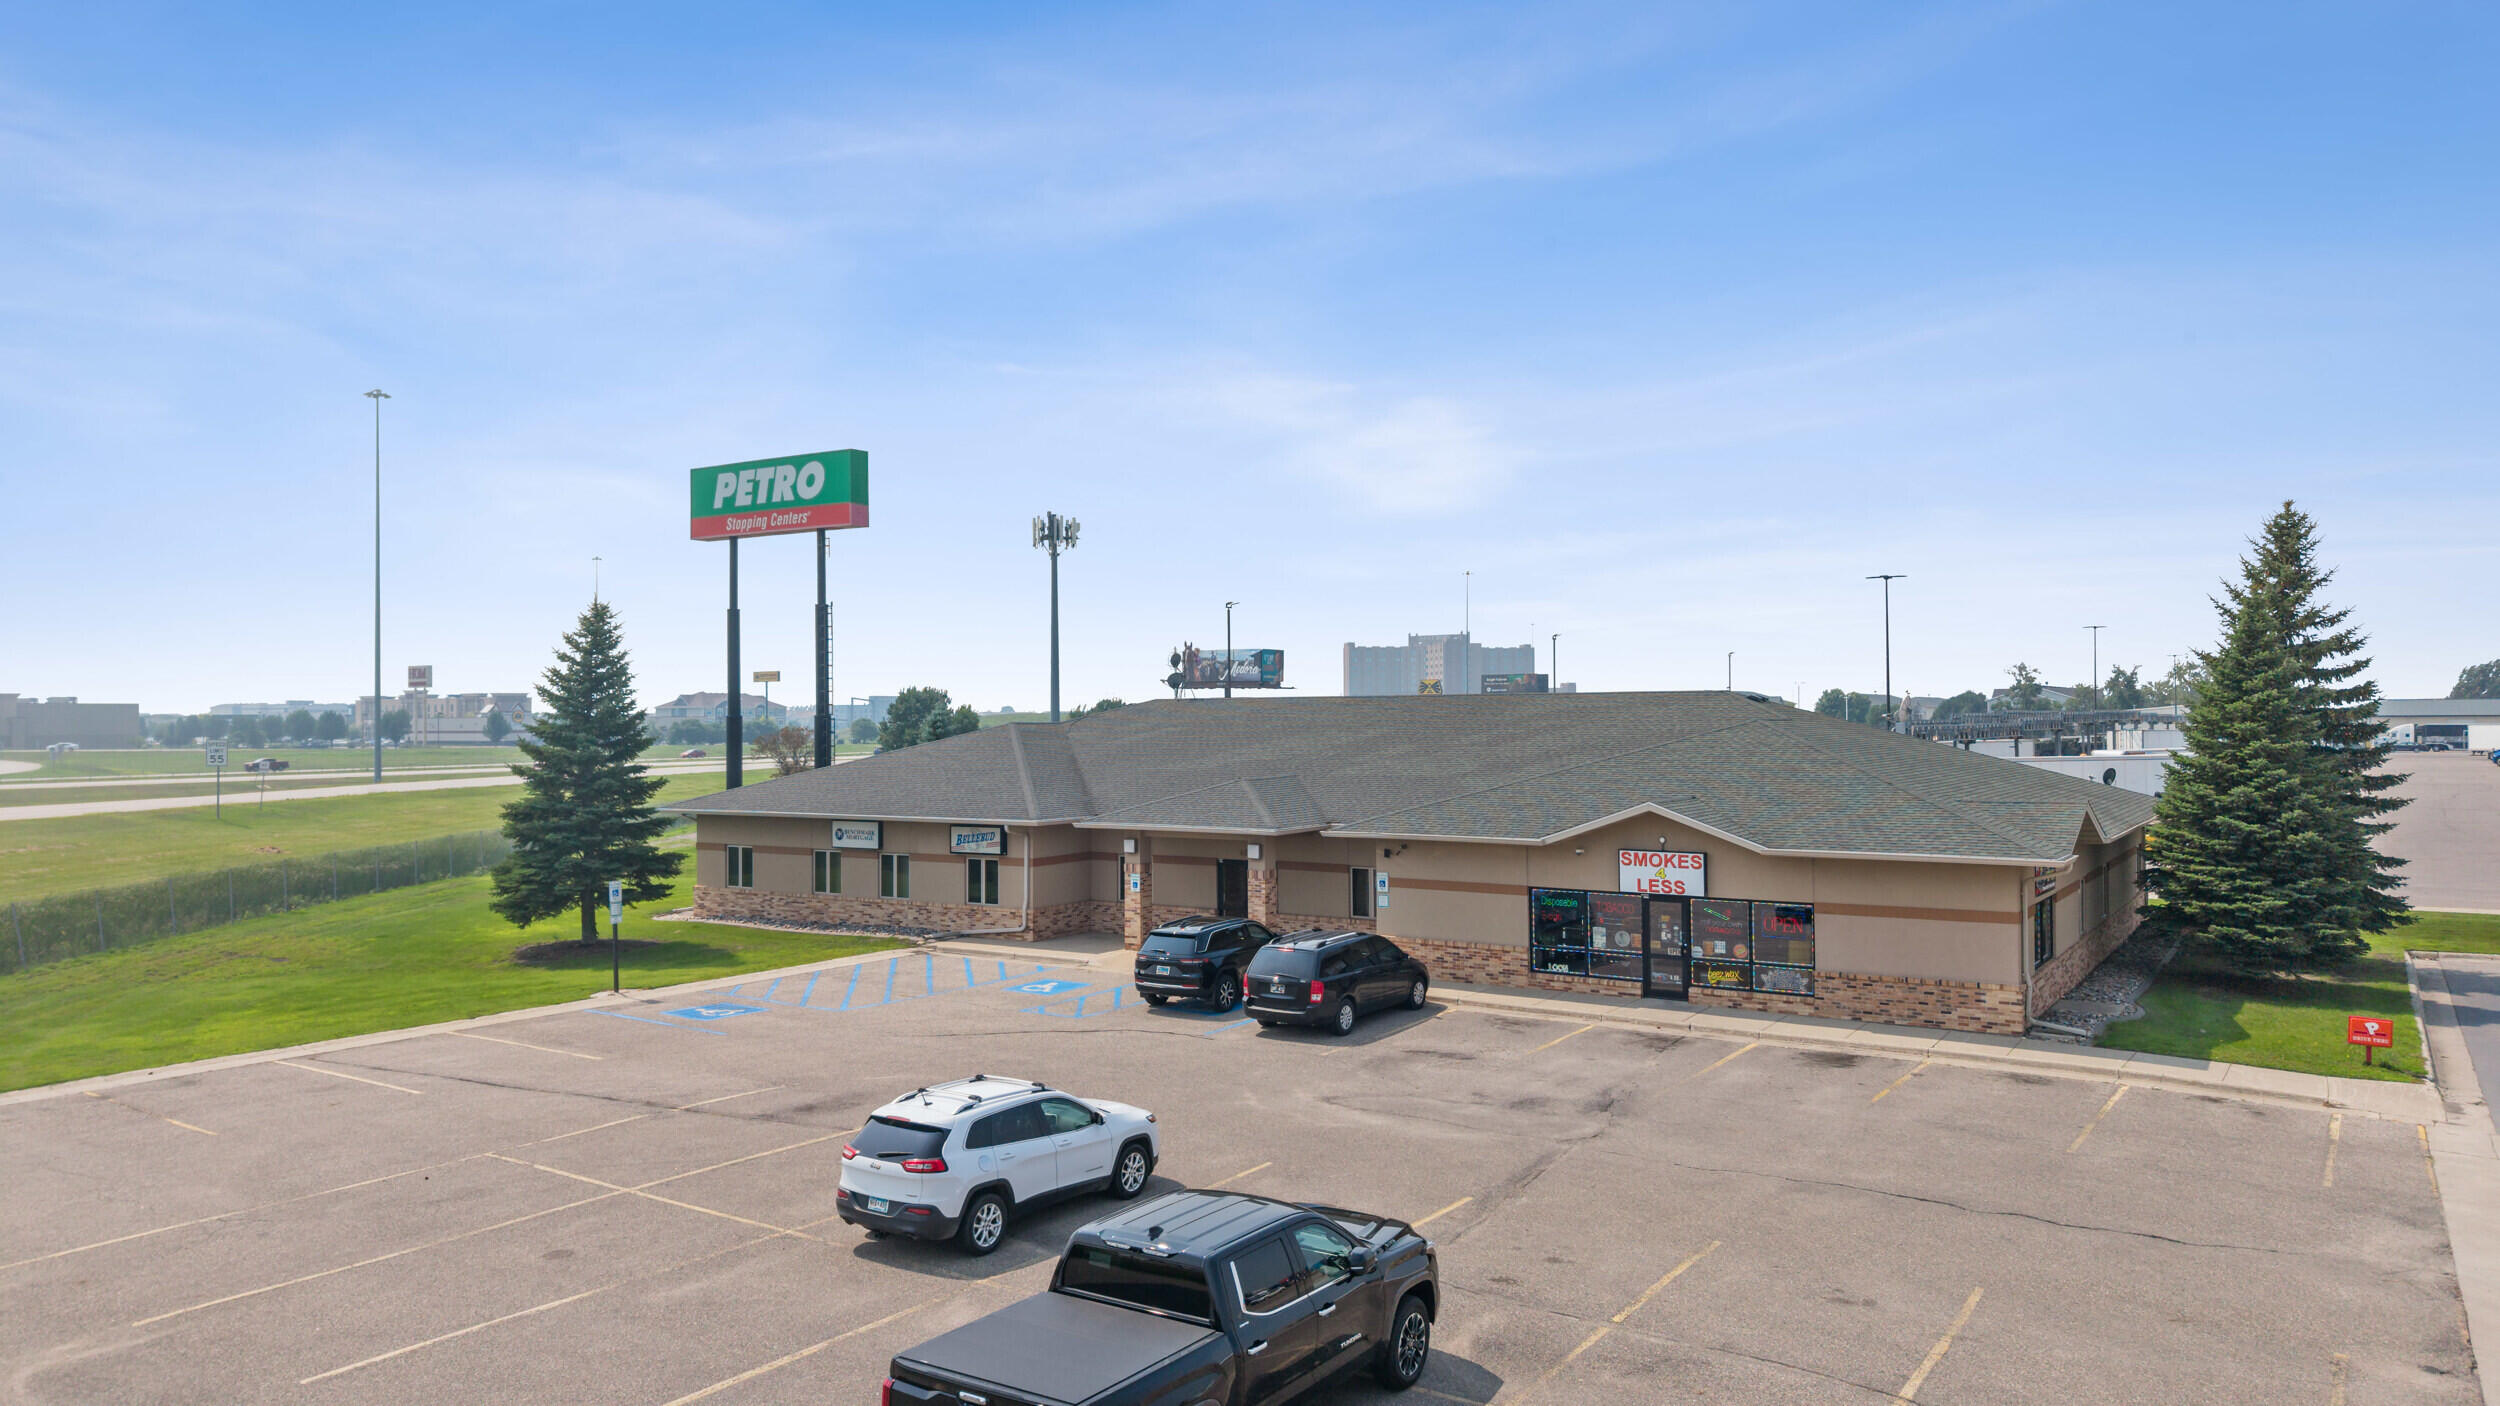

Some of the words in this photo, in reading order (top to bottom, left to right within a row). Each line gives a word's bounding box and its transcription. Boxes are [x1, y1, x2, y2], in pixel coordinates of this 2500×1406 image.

[713, 460, 825, 509] PETRO
[725, 514, 768, 532] Stopping
[209, 754, 225, 763] 55
[1620, 851, 1703, 870] SMOKES
[1655, 867, 1667, 879] 4
[1637, 878, 1686, 895] LESS
[1763, 916, 1803, 934] OPEN
